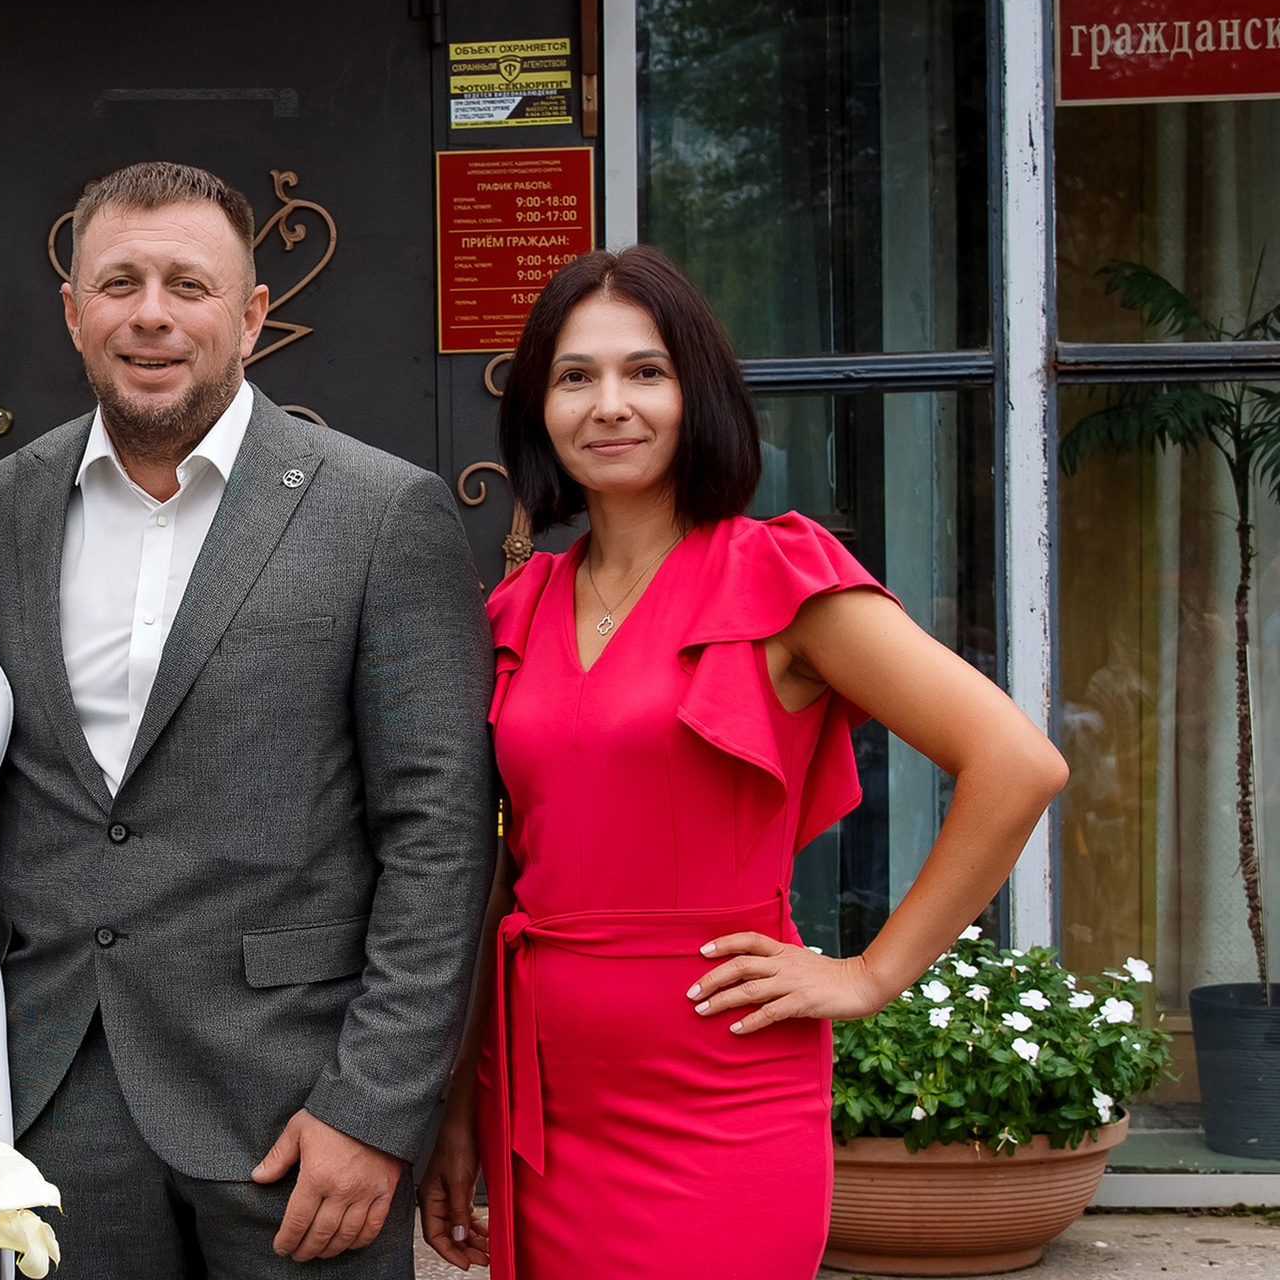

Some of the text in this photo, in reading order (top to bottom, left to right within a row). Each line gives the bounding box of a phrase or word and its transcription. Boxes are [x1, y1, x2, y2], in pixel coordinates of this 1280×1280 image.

[454, 42, 567, 55] ОБЪЕКТ ОХРАНЯЕТСЯ
[1070, 17, 1280, 70] гражданск
[452, 59, 567, 72] ОХРАННЫМ АГЕНТСТВОМ
[477, 181, 552, 191] ГРАФИК РАБОТЫ:
[516, 195, 577, 207] 9:00-18:00
[516, 210, 577, 222] 9:00-17:00
[461, 235, 570, 248] ПРИЁМ ГРАЖДАН:
